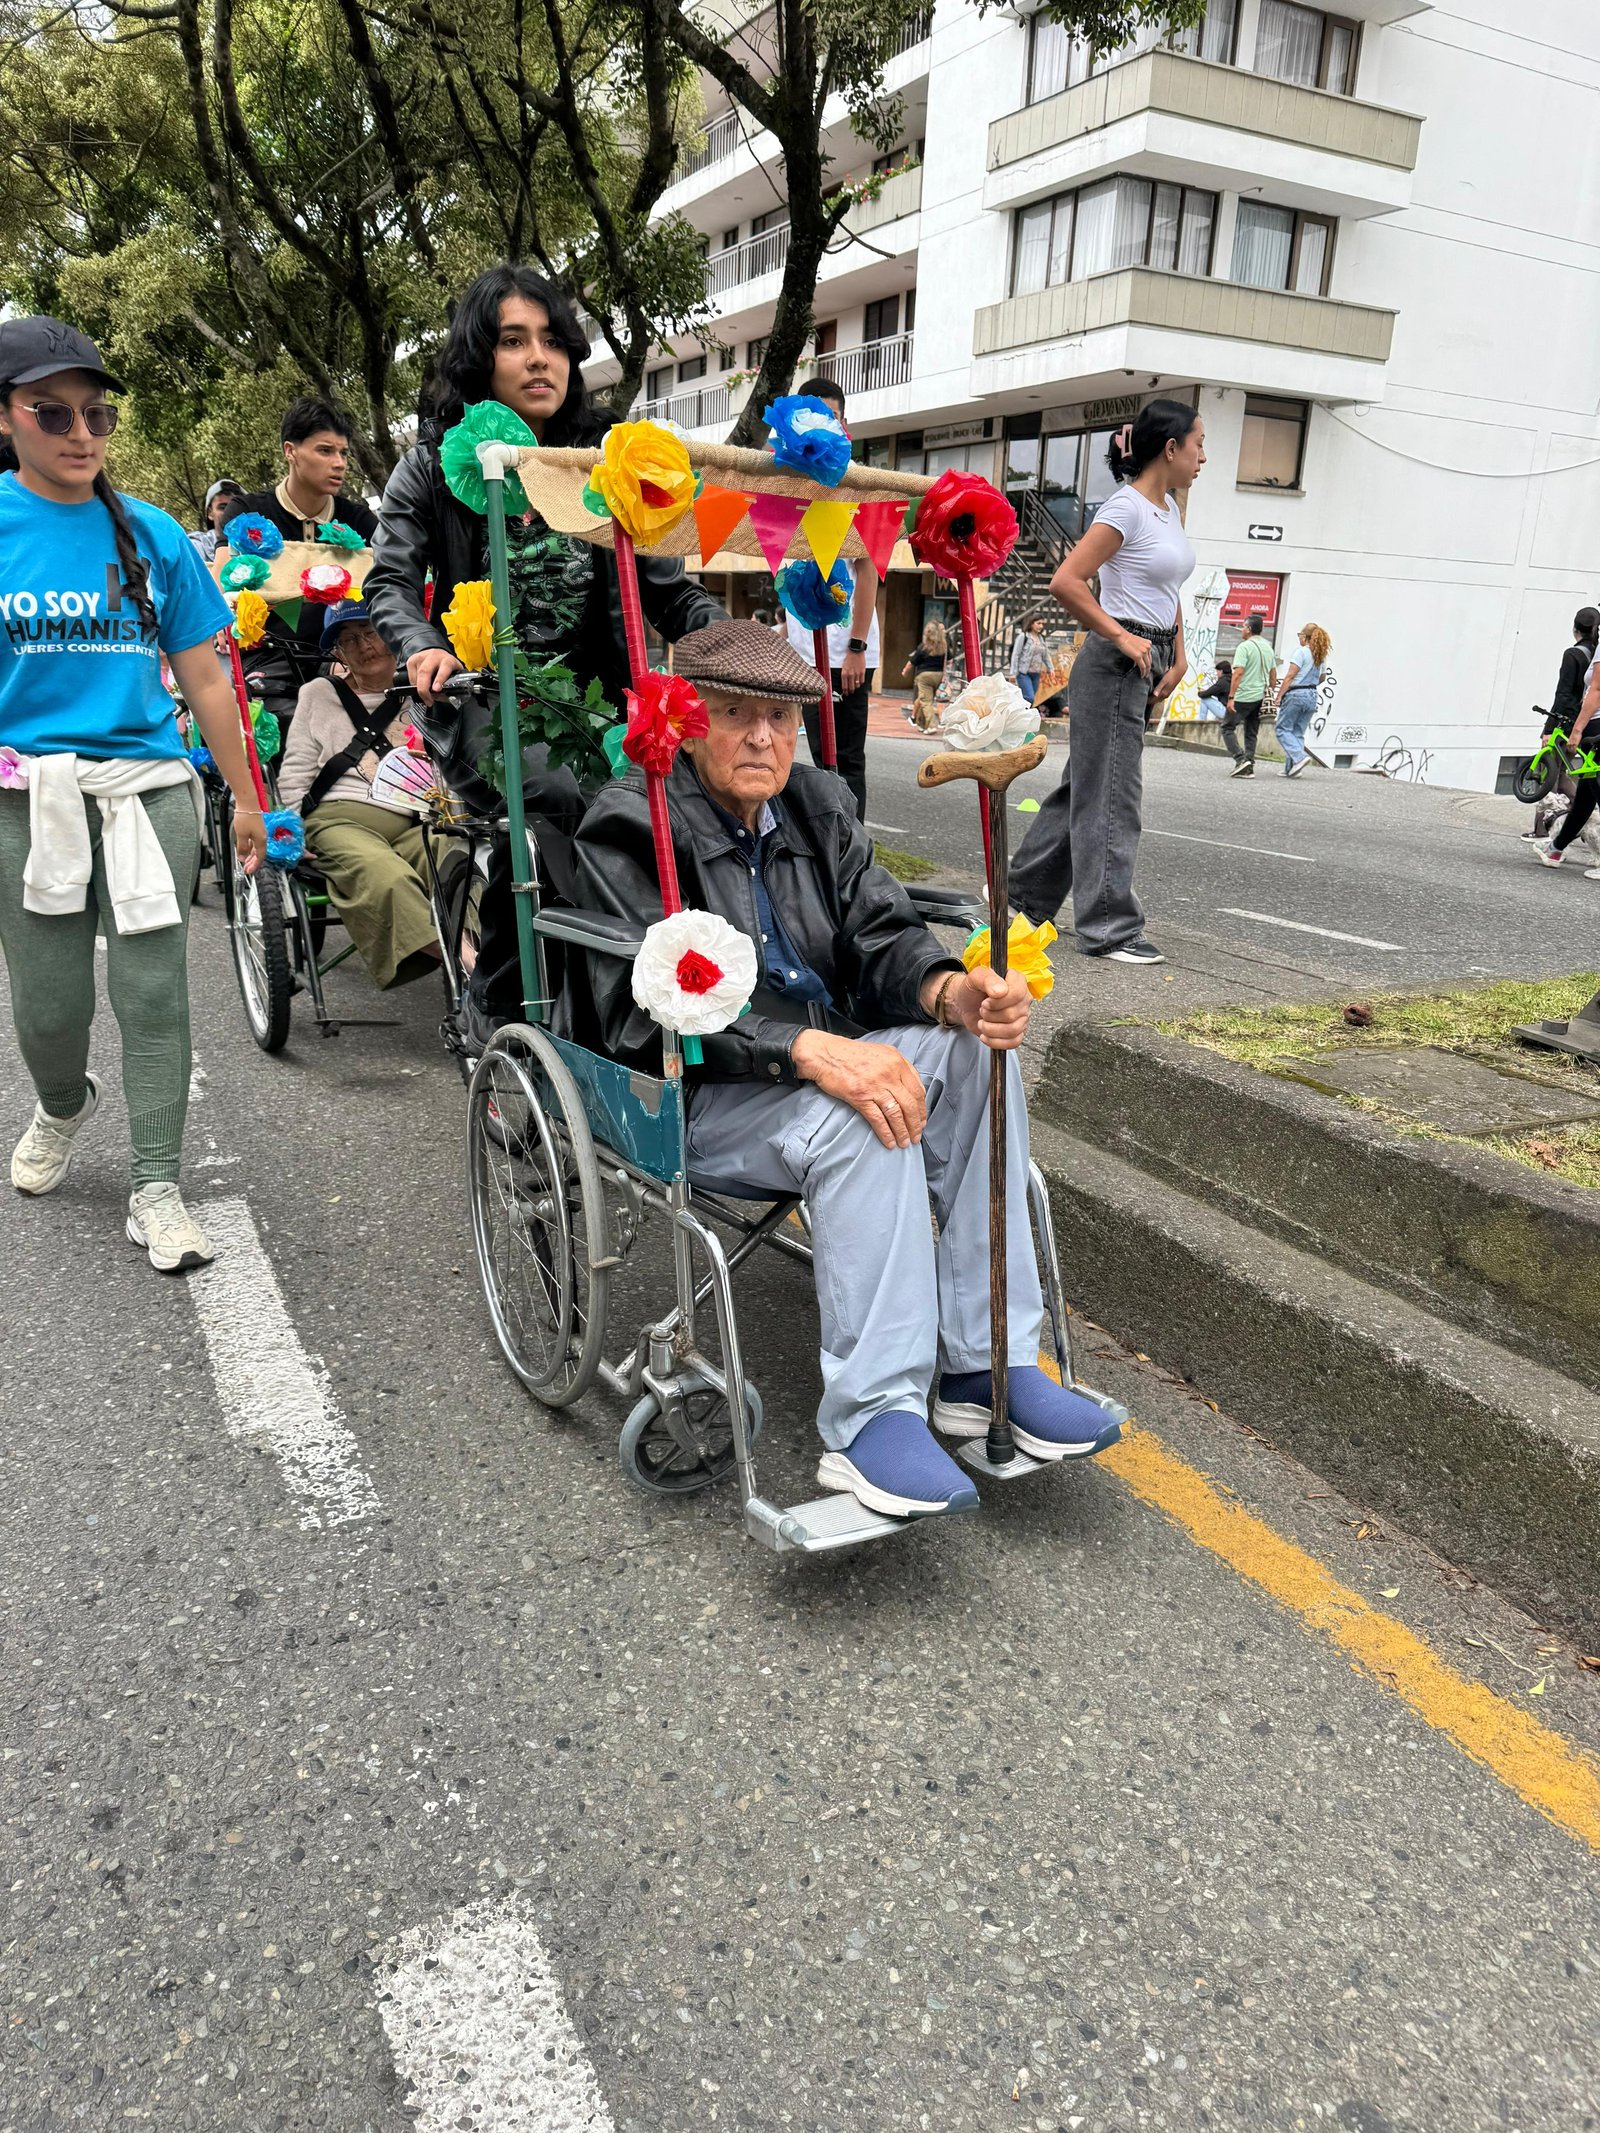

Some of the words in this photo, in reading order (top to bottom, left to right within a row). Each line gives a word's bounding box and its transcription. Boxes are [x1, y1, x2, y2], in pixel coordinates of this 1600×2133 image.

[1083, 396, 1142, 420] GIOVANNI
[1231, 582, 1265, 590] PROMOCIÓN
[0, 591, 39, 620] YO
[44, 590, 101, 618] SOY
[5, 618, 159, 643] HUMANIST
